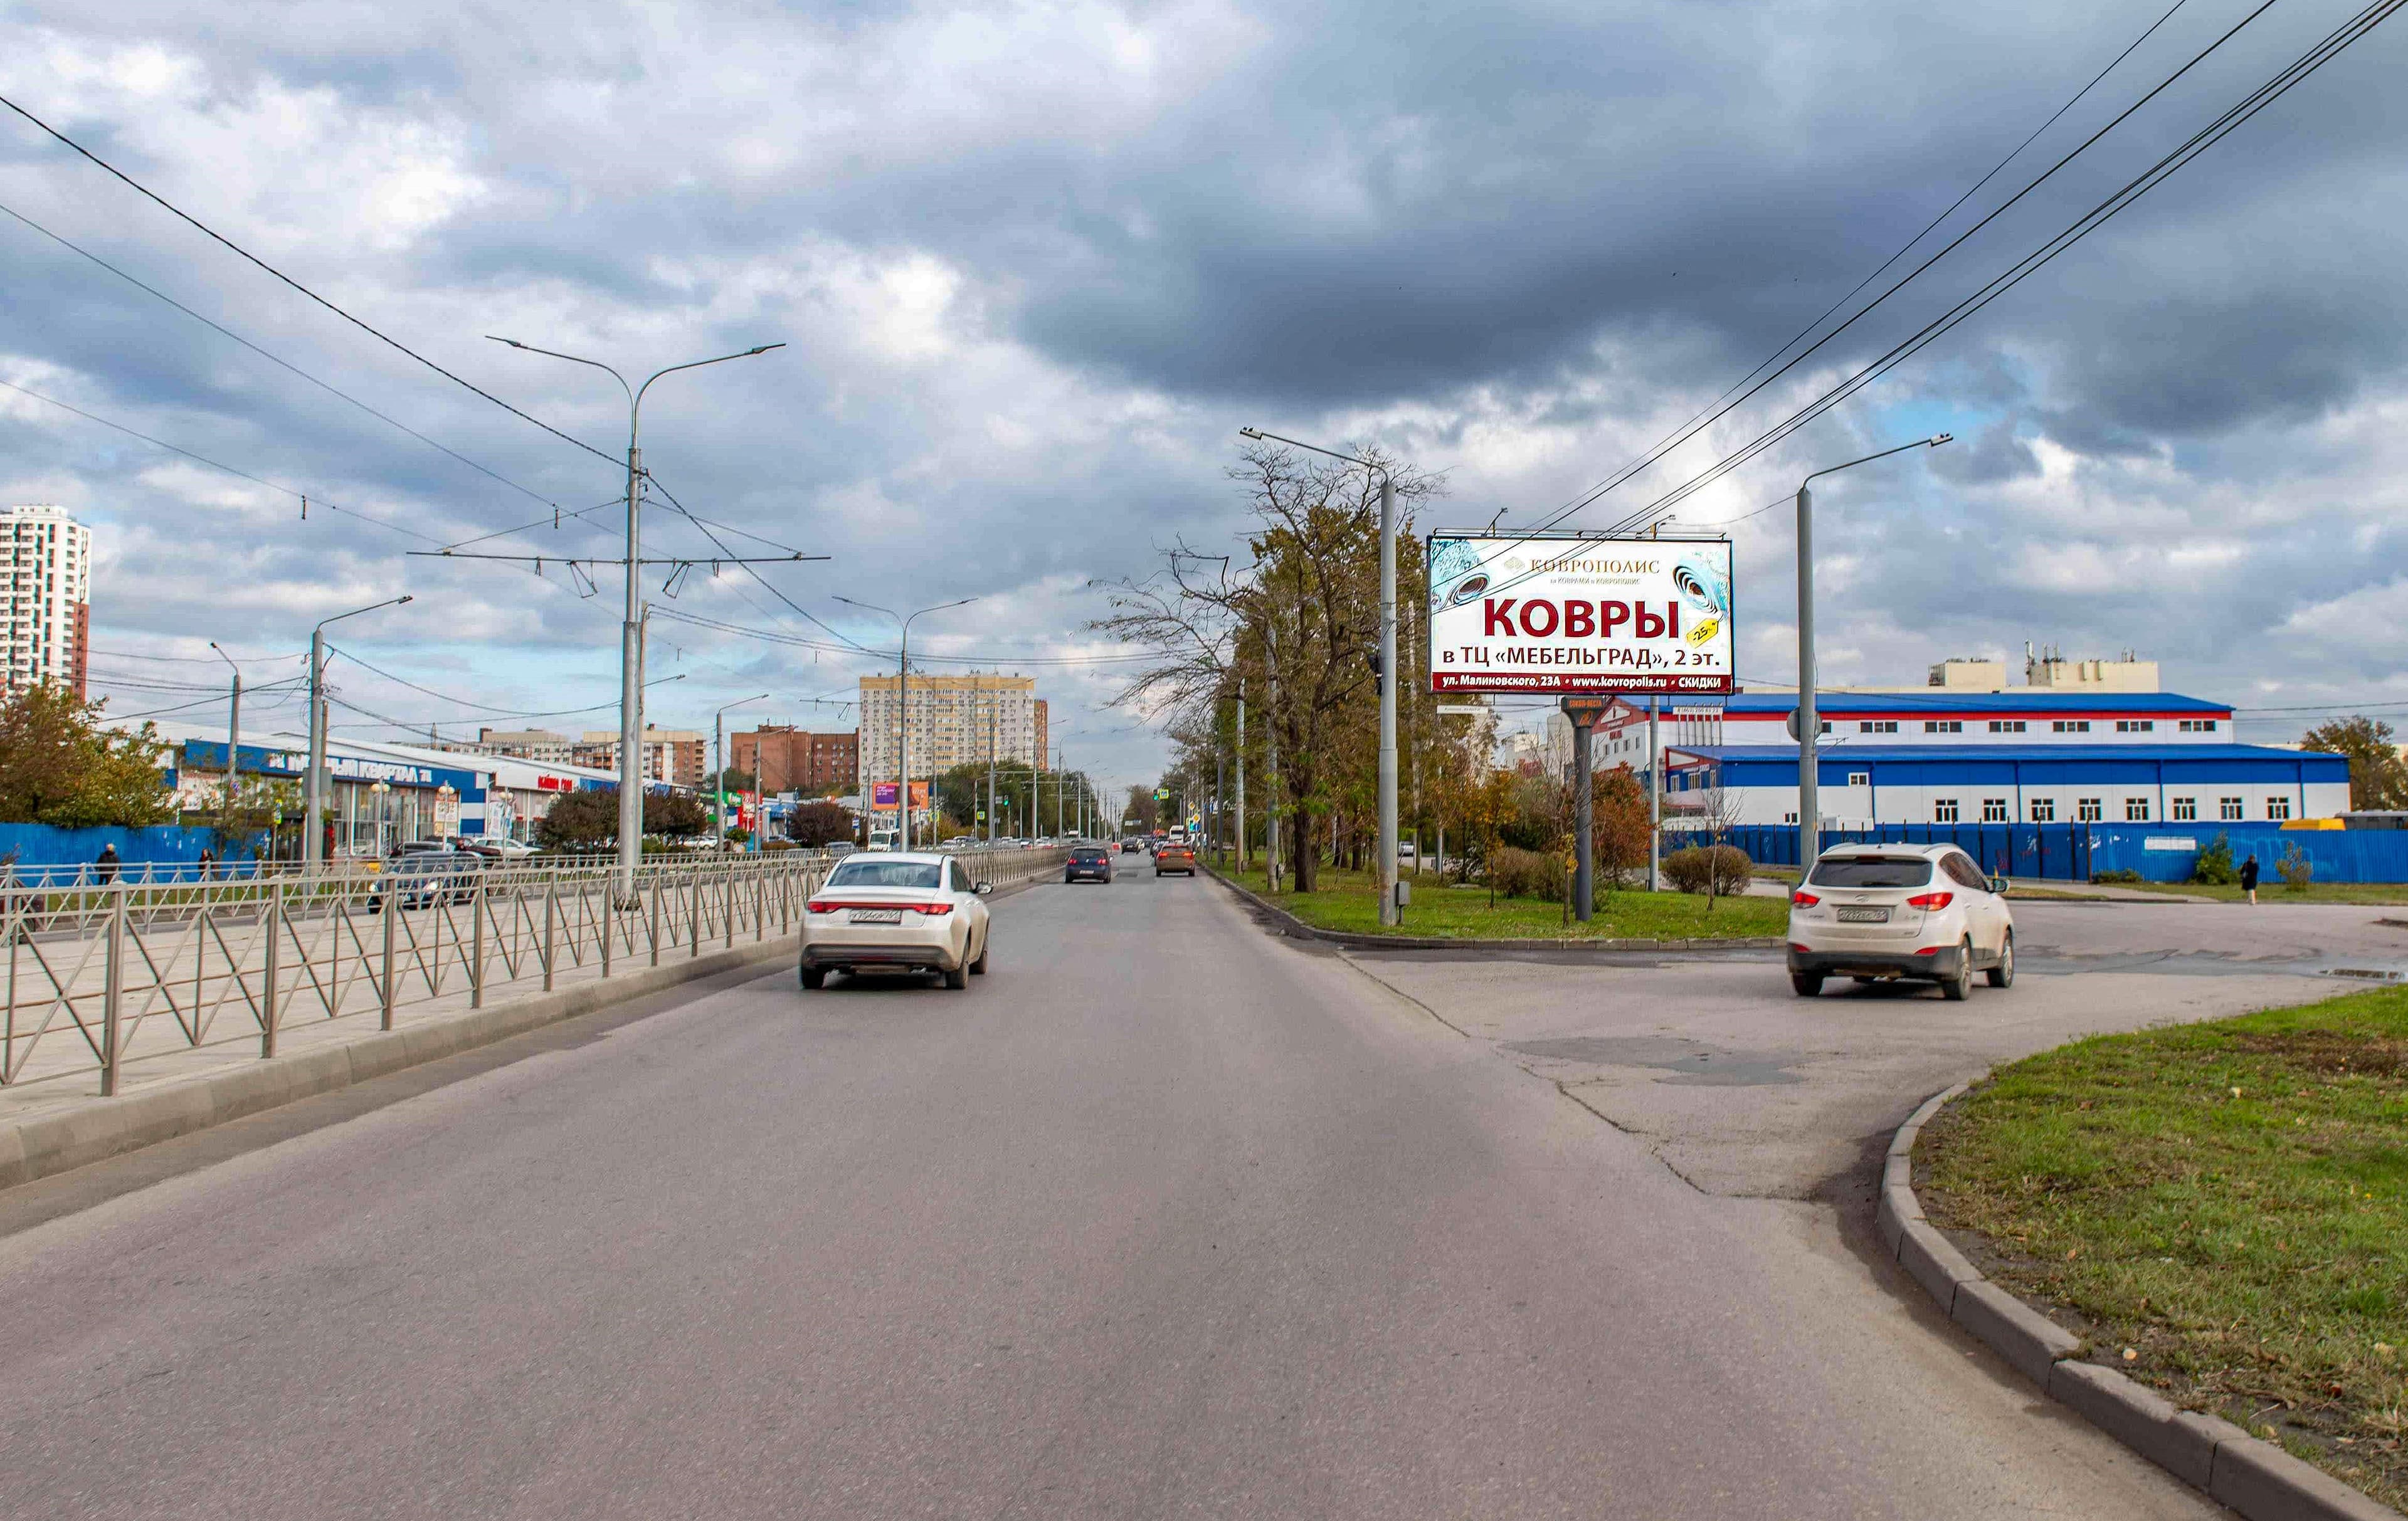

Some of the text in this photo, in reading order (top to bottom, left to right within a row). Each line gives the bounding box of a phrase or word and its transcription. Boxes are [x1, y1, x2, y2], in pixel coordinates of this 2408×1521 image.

[1530, 559, 1661, 574] КОВРОПОЛИС
[1484, 598, 1680, 638] КОВРЫ
[1443, 646, 1720, 669] в ТЦ «МЕБЕЛЬГРАД», 2 эт.
[1443, 675, 1561, 687] ул. Малиновского, 23А
[1572, 676, 1667, 689] www.kovropolis.ru
[1678, 676, 1721, 689] СКИДКИ
